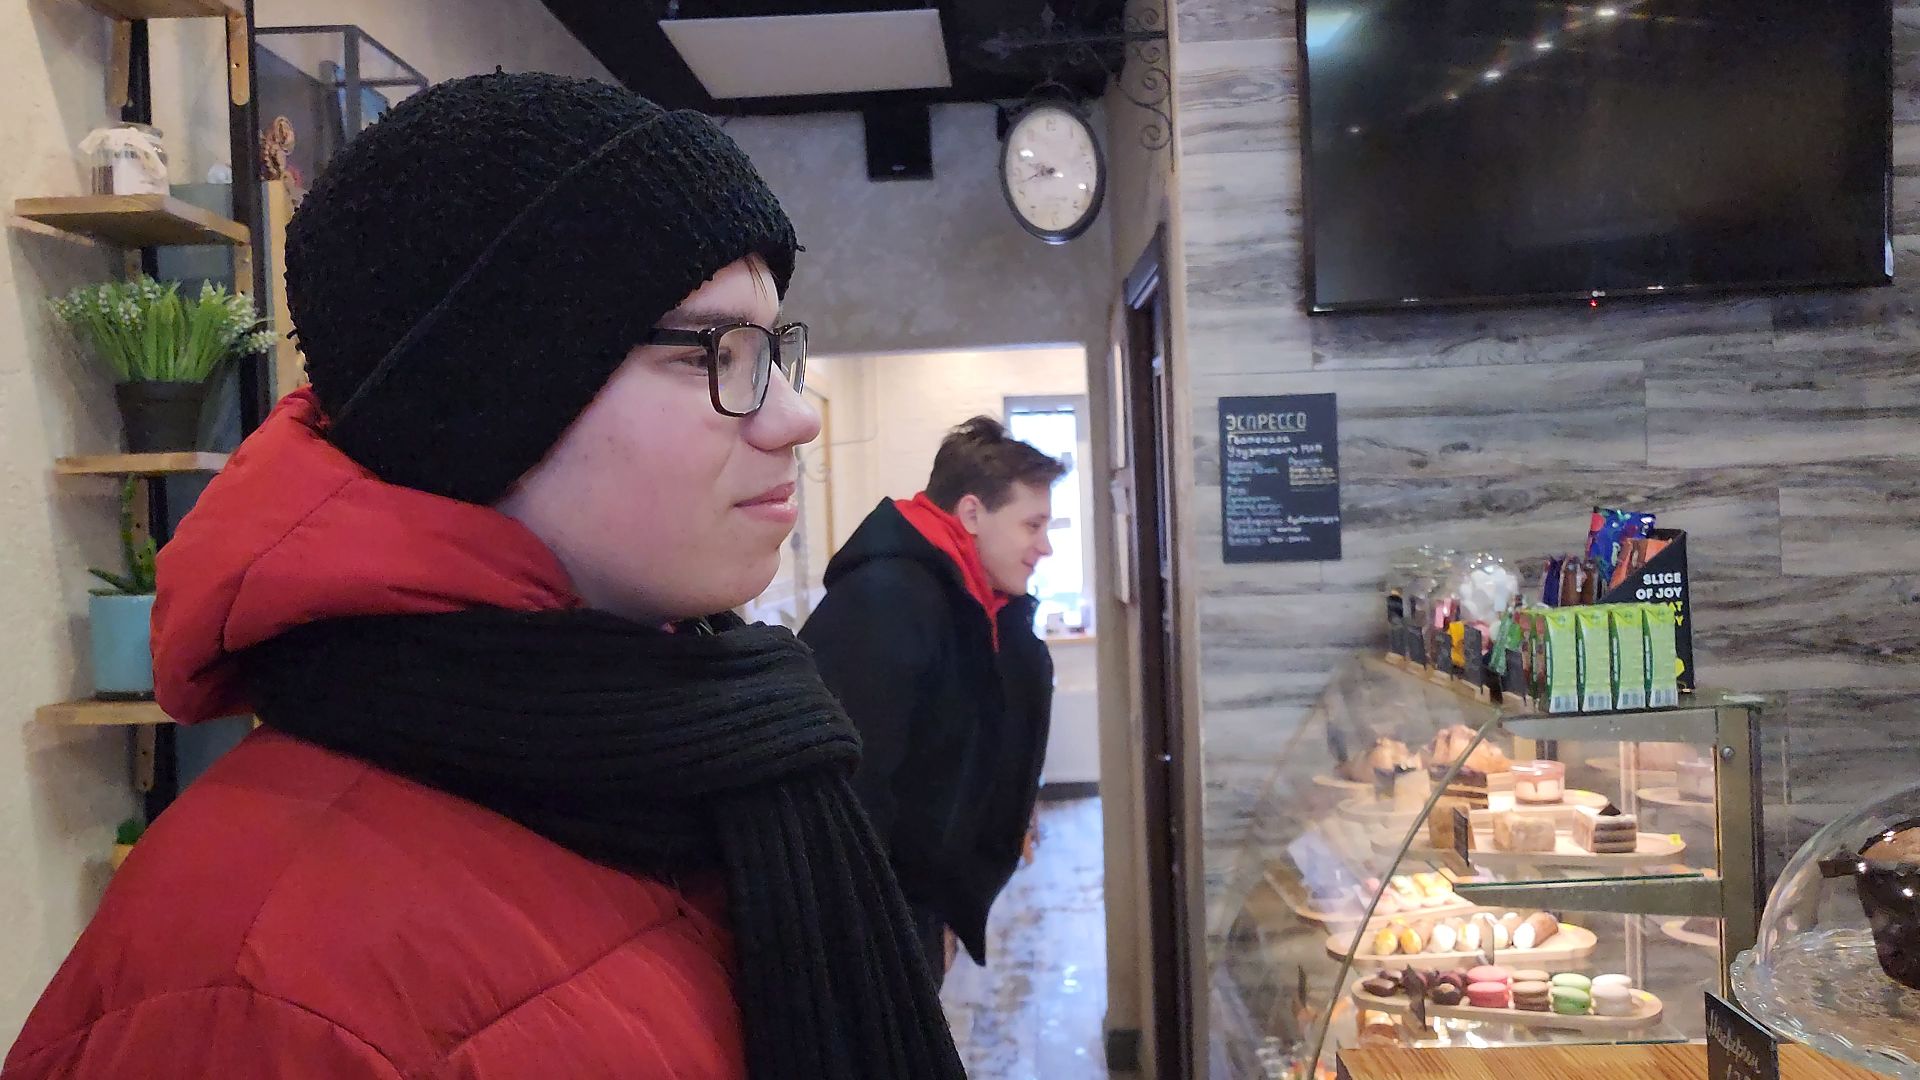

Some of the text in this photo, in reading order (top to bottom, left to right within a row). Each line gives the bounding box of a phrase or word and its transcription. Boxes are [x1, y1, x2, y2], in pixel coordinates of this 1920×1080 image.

[1225, 411, 1307, 431] ЭСПРЕССО
[1642, 571, 1682, 585] SLICE
[1635, 587, 1682, 600] OF JOY
